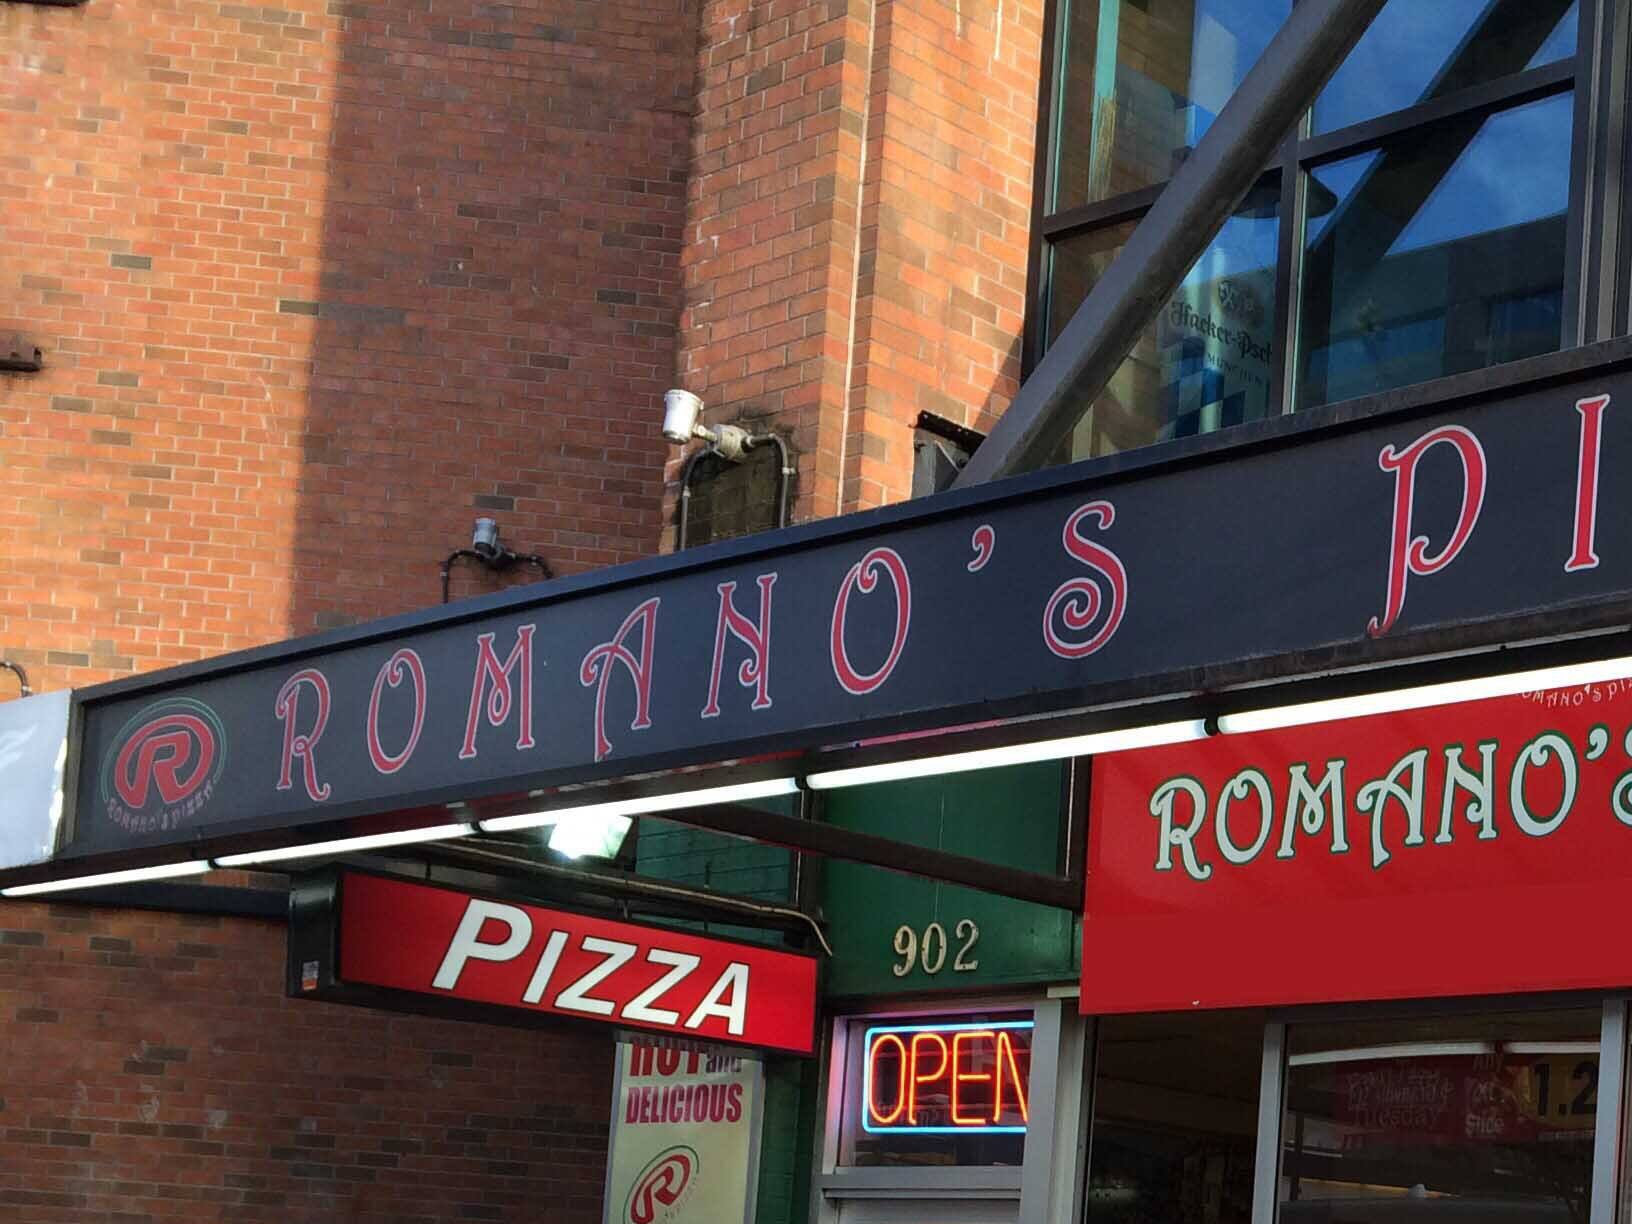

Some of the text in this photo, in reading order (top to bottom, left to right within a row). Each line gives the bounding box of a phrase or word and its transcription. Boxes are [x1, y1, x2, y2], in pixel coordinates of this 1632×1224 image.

[274, 500, 1129, 802] ROMANO'S
[432, 897, 751, 1036] PIZZA
[894, 919, 978, 976] 902
[625, 1083, 743, 1124] DELICIOUS
[869, 1031, 1028, 1125] OPEN
